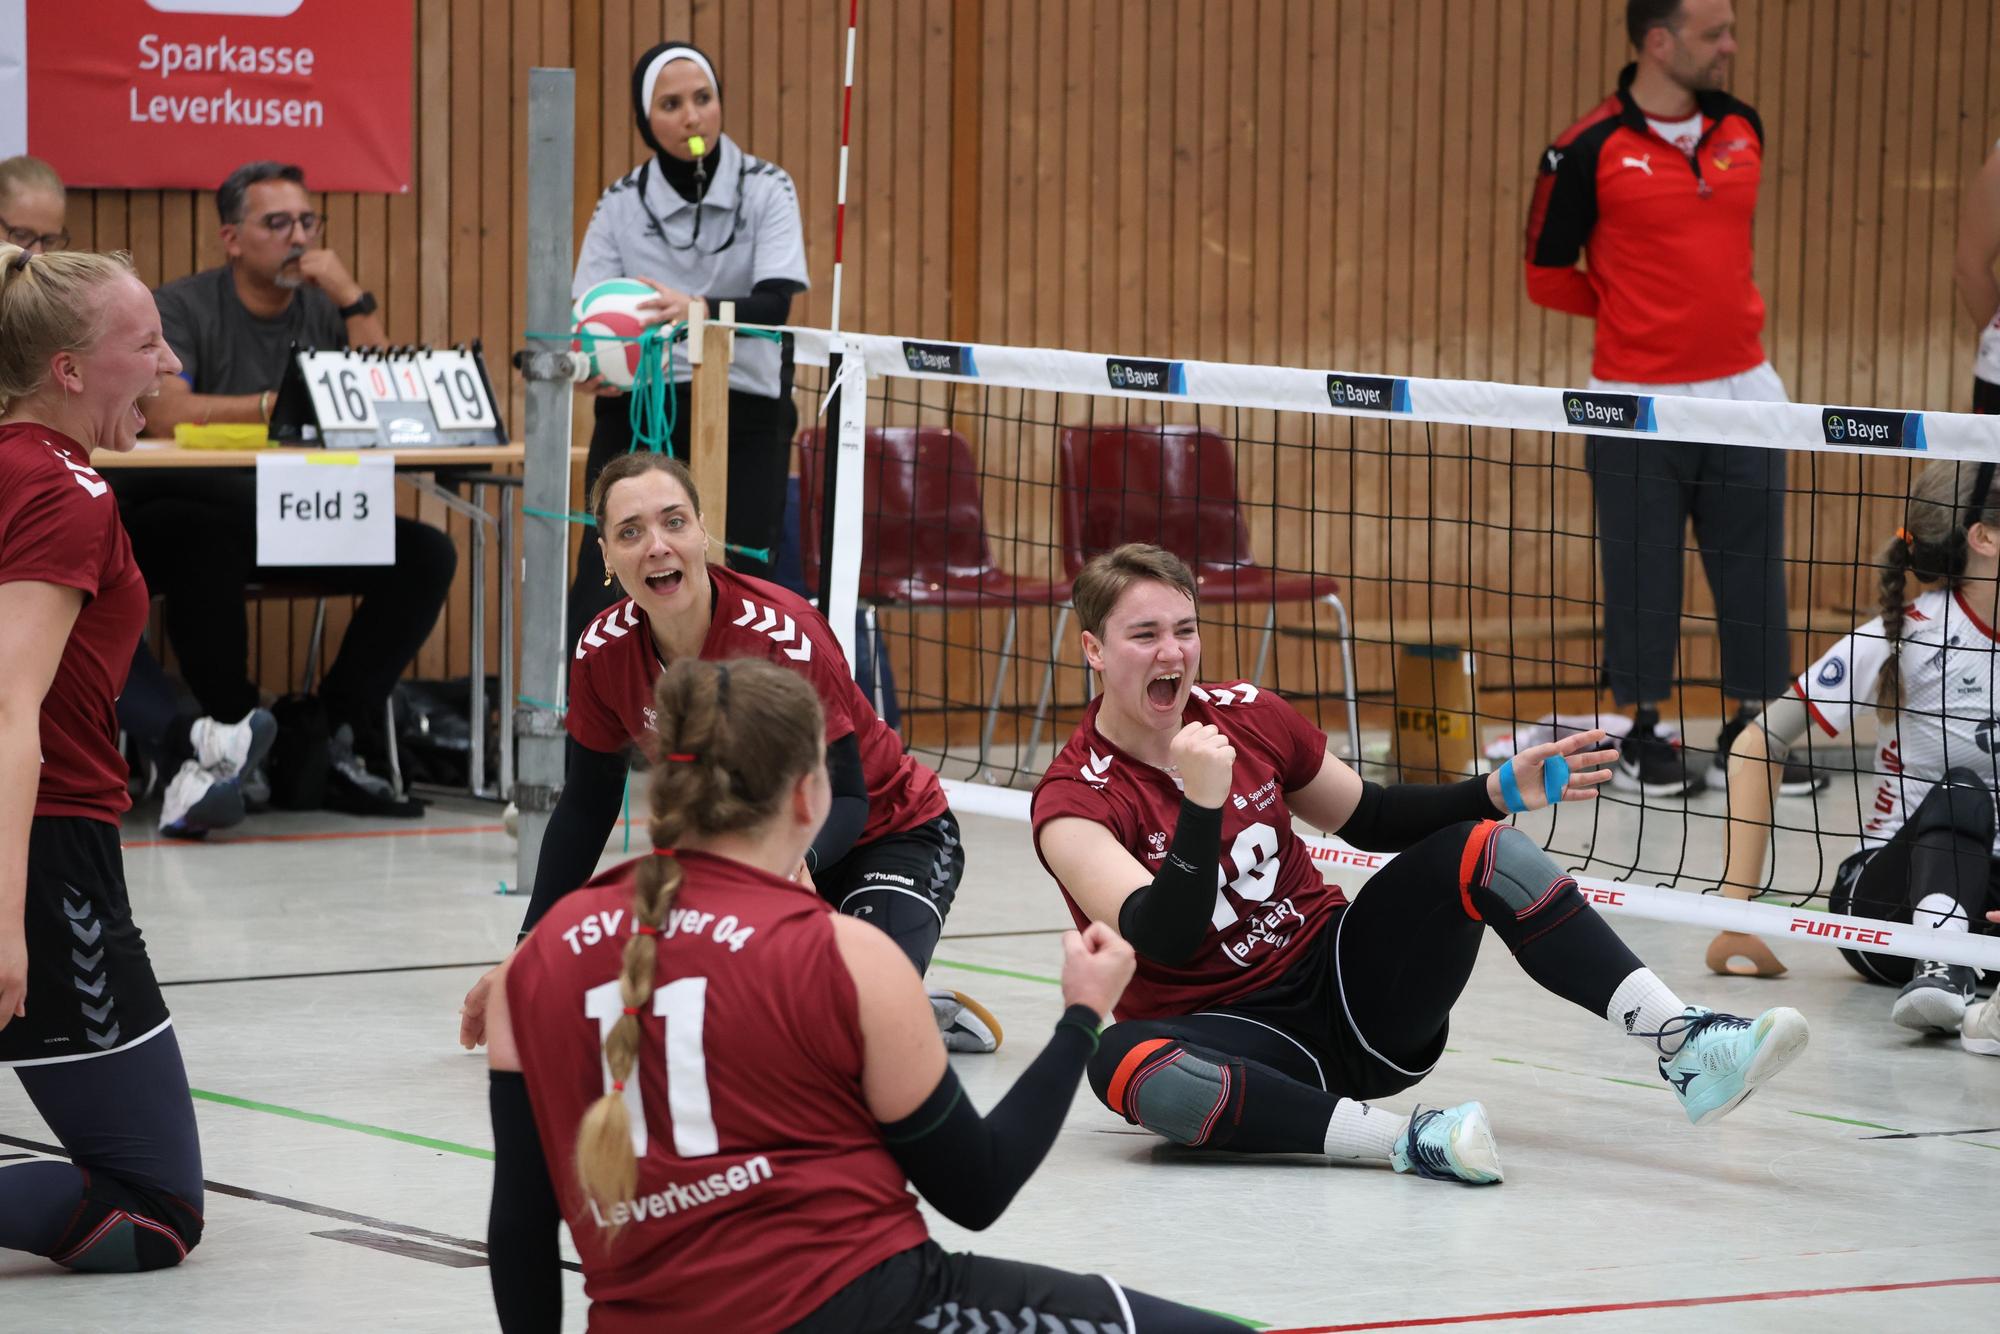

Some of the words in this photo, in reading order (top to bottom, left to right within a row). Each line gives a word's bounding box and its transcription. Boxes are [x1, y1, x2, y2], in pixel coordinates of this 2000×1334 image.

[138, 33, 315, 79] Sparkasse
[129, 86, 324, 127] Leverkusen
[919, 349, 951, 370] Bayer
[1125, 366, 1160, 388] Bayer
[318, 369, 369, 422] 16
[370, 367, 387, 397] 0
[403, 367, 417, 397] 1
[434, 369, 484, 421] 19
[1345, 383, 1381, 406] Bayer
[1585, 401, 1625, 424] Bayer
[1846, 418, 1890, 442] Bayer
[279, 490, 342, 521] Feld
[353, 491, 370, 521] 3
[875, 871, 915, 887] hummel
[1580, 887, 1626, 907] TEC
[562, 908, 625, 956] TSV
[712, 914, 756, 953] 04
[1232, 903, 1290, 958] BAYER
[1790, 918, 1893, 946] FUNTEC
[584, 975, 720, 1159] 11
[588, 1154, 774, 1229] Leverkusen
